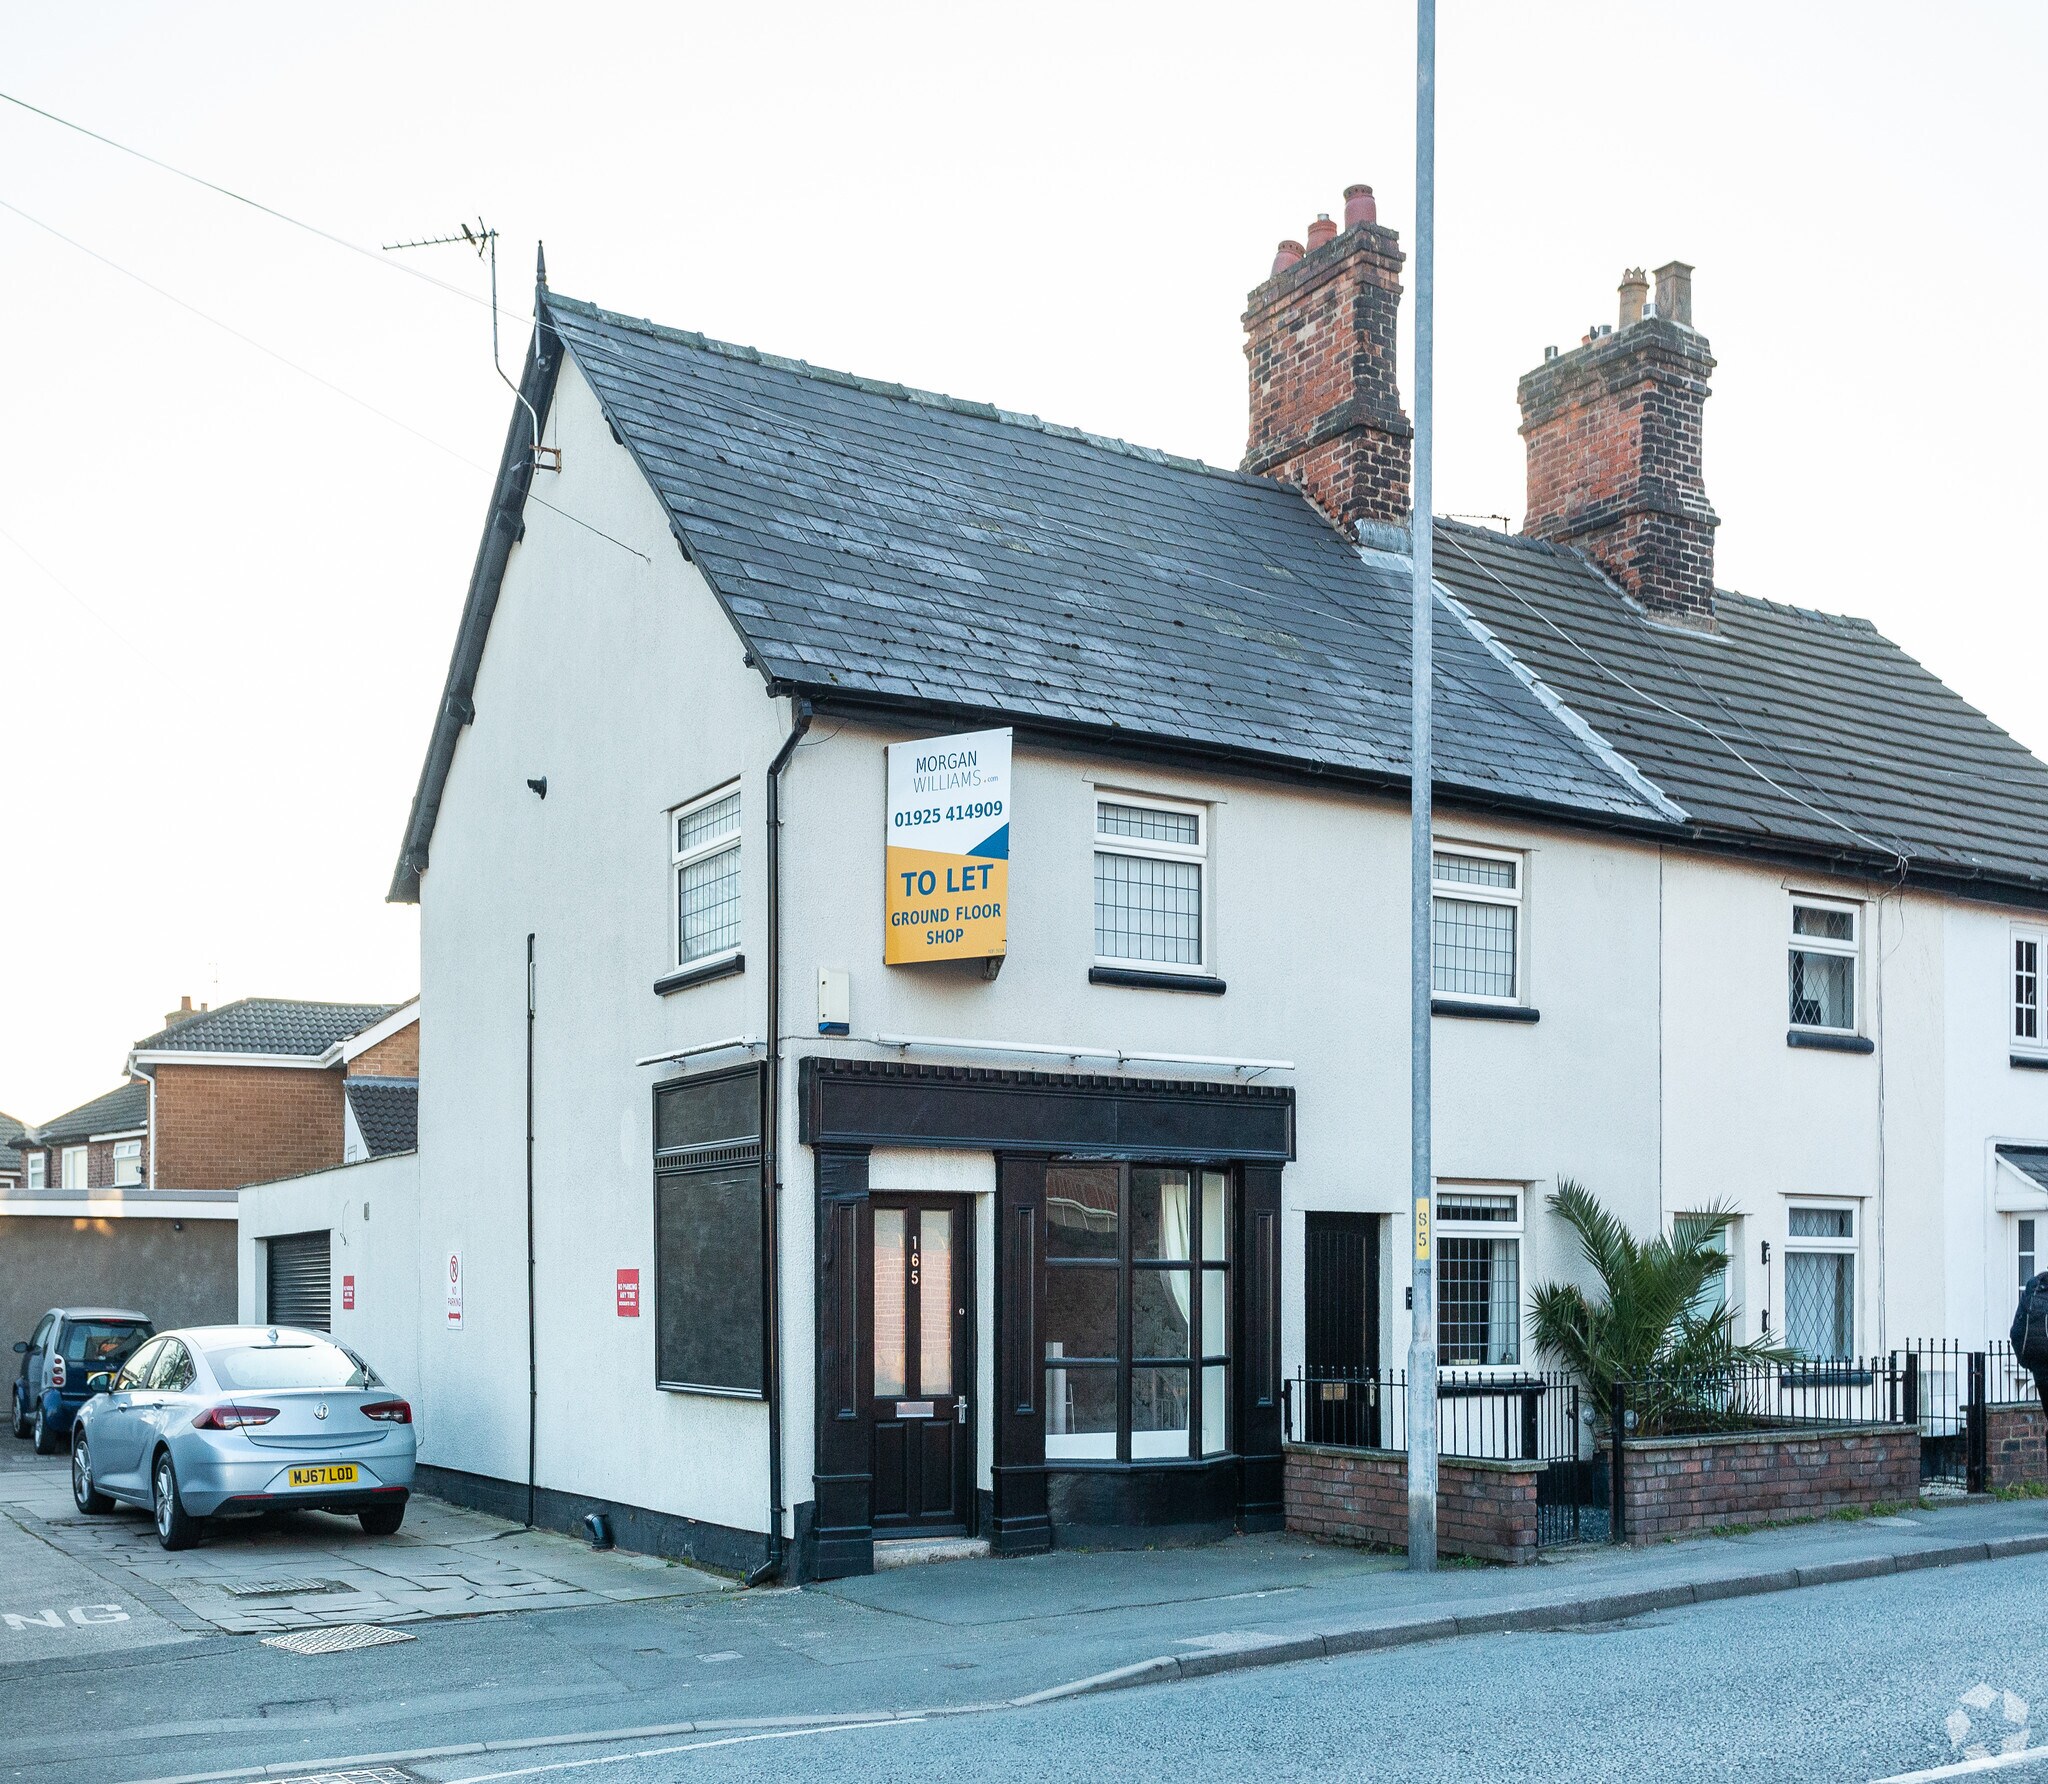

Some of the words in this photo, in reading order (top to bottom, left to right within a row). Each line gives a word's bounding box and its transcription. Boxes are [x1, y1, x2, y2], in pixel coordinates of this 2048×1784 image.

[916, 750, 977, 773] MORGAN
[894, 808, 941, 827] 01925
[945, 800, 1003, 821] 414909
[901, 870, 936, 897] TO
[946, 863, 994, 893] LET
[891, 908, 949, 926] GROUND
[956, 903, 1001, 920] FLOOR
[926, 928, 964, 945] SHOP
[294, 1469, 326, 1484] MJ67
[329, 1467, 353, 1481] LOD
